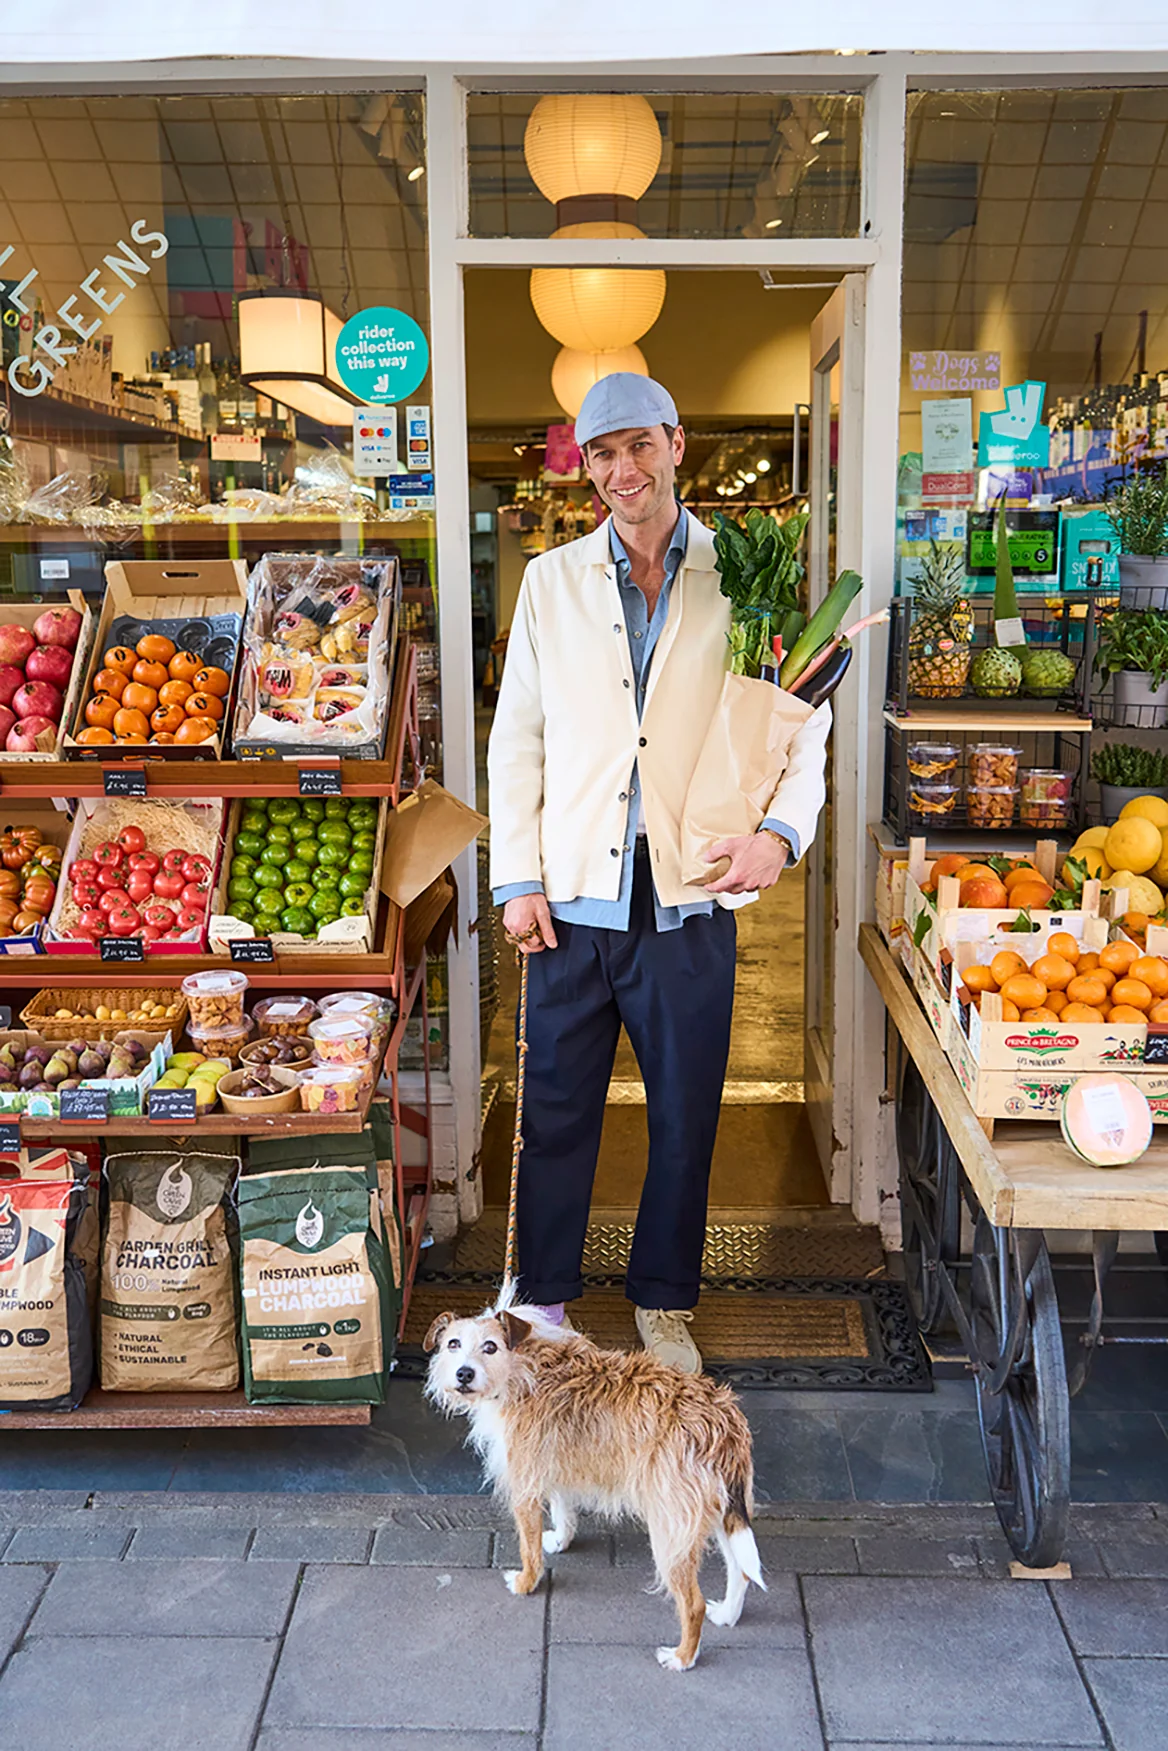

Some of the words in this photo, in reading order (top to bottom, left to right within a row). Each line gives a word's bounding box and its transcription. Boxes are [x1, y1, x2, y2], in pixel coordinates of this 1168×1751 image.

[8, 219, 169, 397] GREENS
[358, 324, 394, 339] rider
[341, 339, 415, 356] collection
[347, 357, 376, 370] this
[379, 355, 407, 370] way
[932, 350, 979, 376] Dogs
[911, 374, 999, 391] Welcome
[1037, 550, 1046, 562] 5
[1006, 1038, 1031, 1047] PRINCE
[1040, 1037, 1077, 1047] BRETAGNE
[176, 1239, 214, 1253] GRILL
[116, 1252, 218, 1270] CHARCOAL
[259, 1266, 318, 1281] INSTANT
[321, 1261, 361, 1277] LIGHT
[259, 1272, 365, 1299] LUMPWOOD
[260, 1288, 366, 1313] CHARCOAL
[119, 1332, 163, 1343] NATURAL
[119, 1344, 159, 1353] ETHICAL
[119, 1355, 187, 1364] SUSTAINABLE
